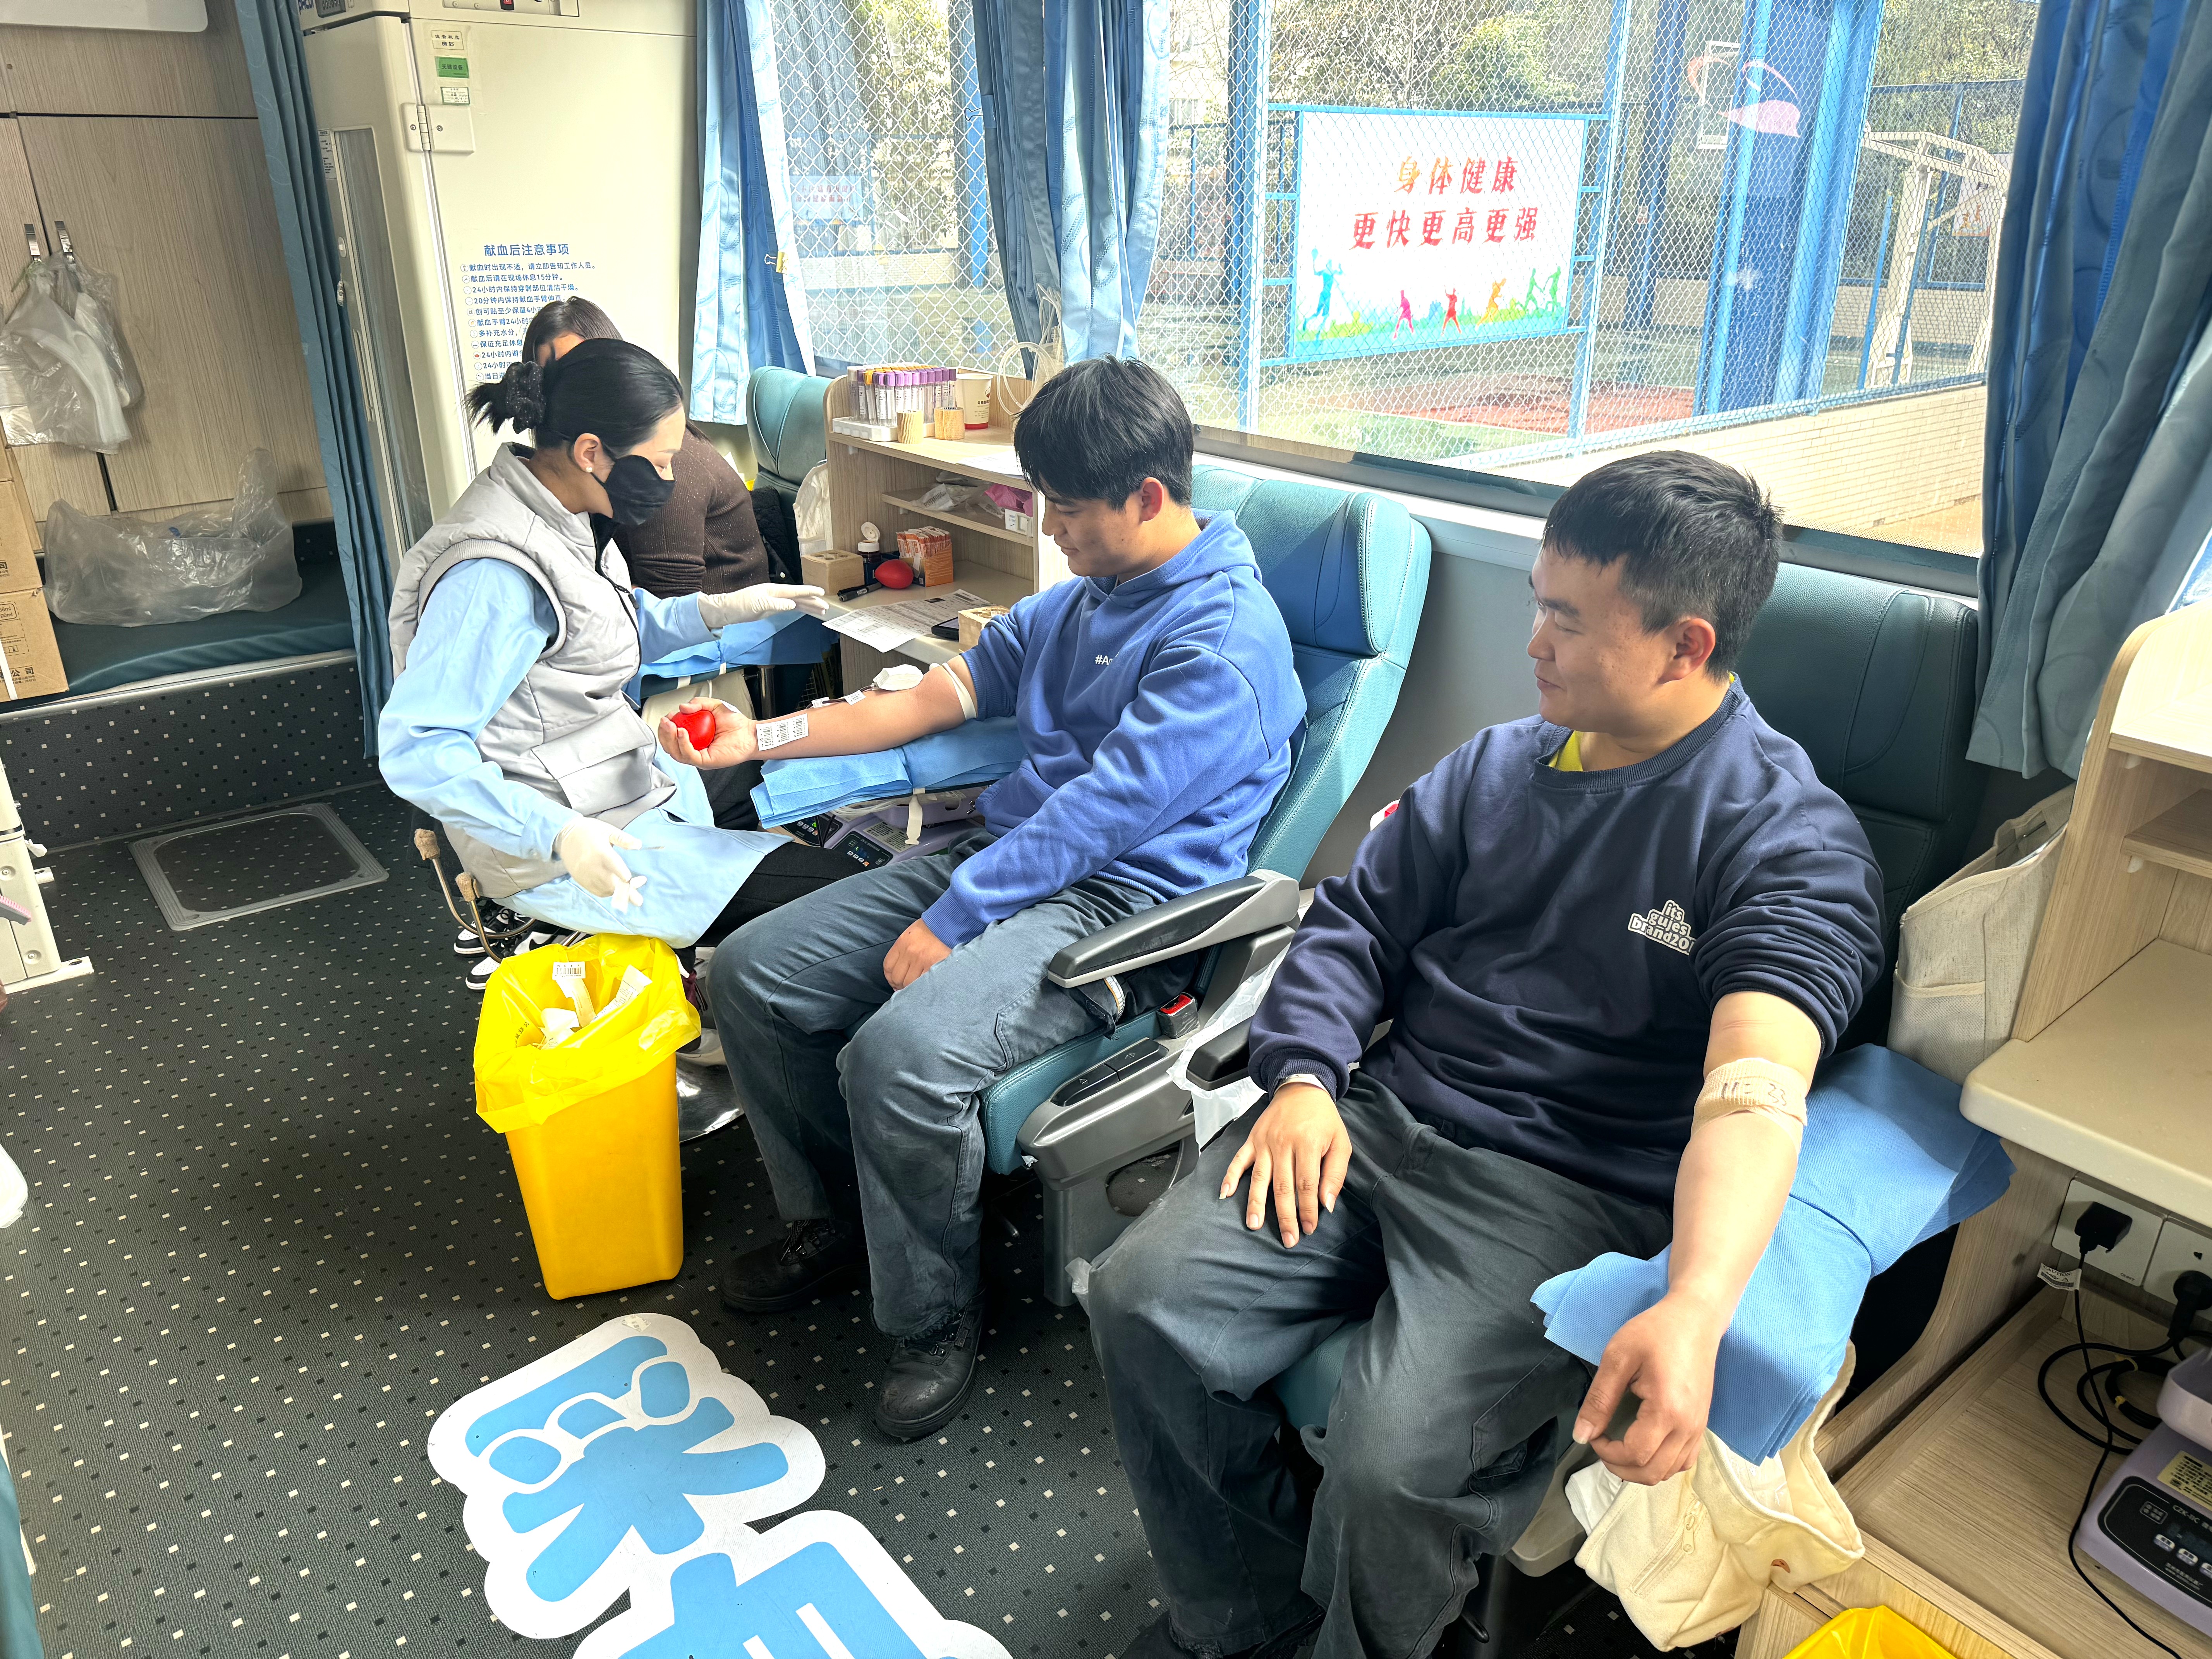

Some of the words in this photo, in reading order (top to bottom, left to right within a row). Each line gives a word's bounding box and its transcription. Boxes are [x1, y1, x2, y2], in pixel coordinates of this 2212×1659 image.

[1394, 156, 1518, 195] 身体健康
[1348, 206, 1538, 251] 更快更高更强
[484, 244, 569, 256] 献血后注意事项
[469, 262, 595, 271] 献血时出现不适，请立即告知工作人员。
[471, 273, 563, 282] 献血后请在现场休息15分钟。
[472, 284, 578, 293] 24小时内保持穿刺部位清洁干燥。
[1665, 904, 1682, 921] its
[1649, 913, 1687, 935] gujes
